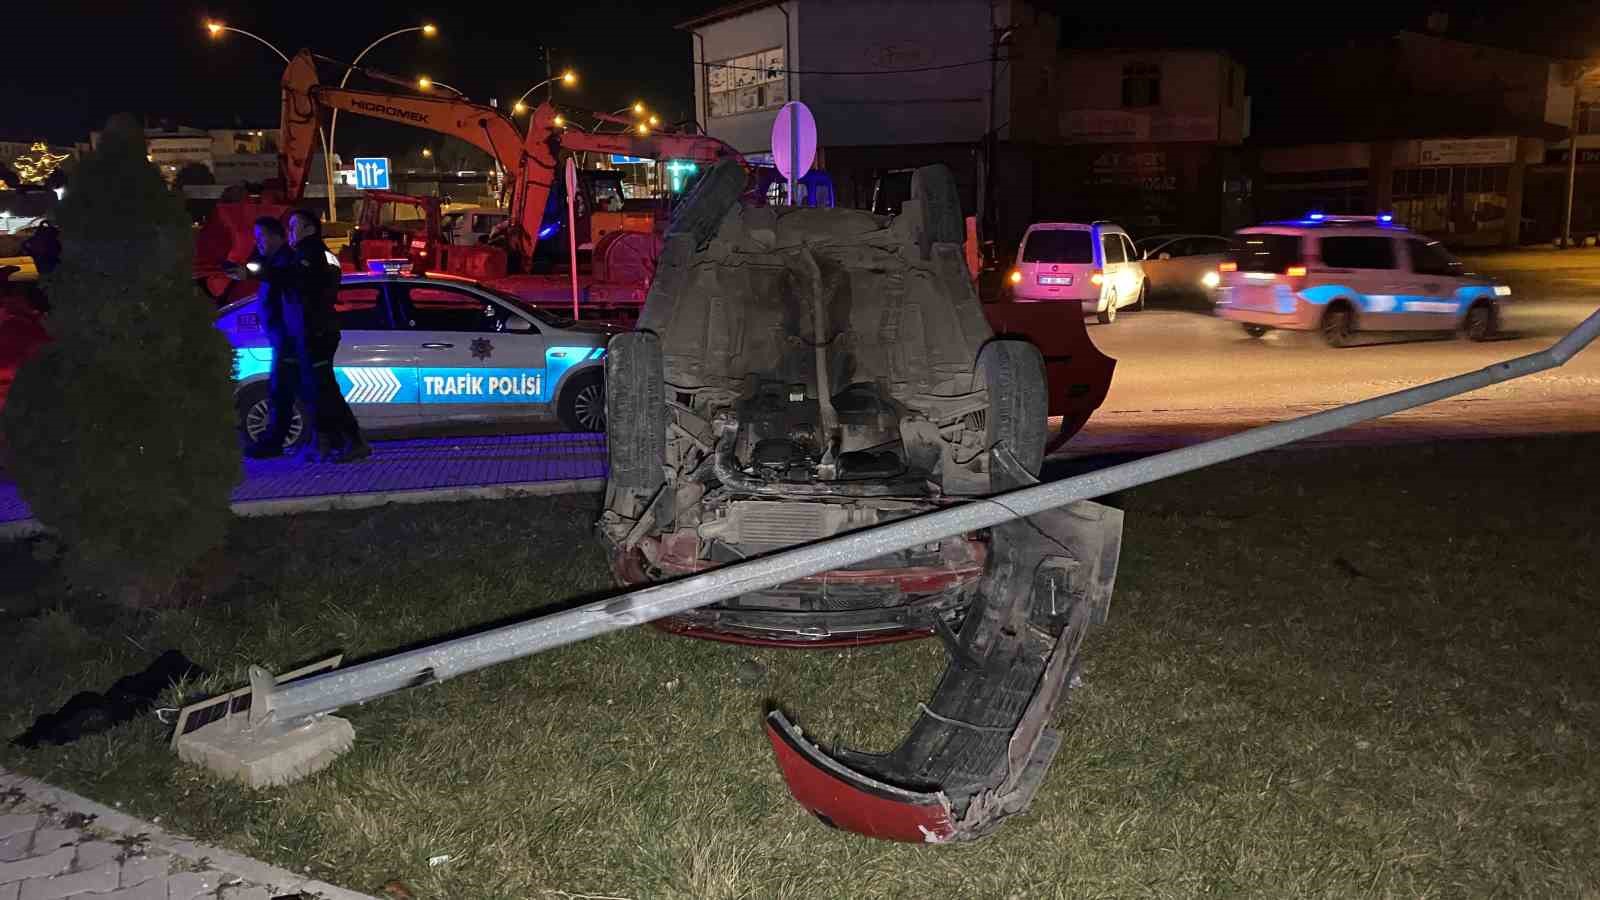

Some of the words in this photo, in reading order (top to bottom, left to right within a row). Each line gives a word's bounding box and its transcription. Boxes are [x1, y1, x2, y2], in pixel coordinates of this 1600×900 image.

[351, 98, 429, 123] HIDROMEK
[423, 372, 483, 396] TRAFİK
[488, 372, 541, 396] POLİSİ
